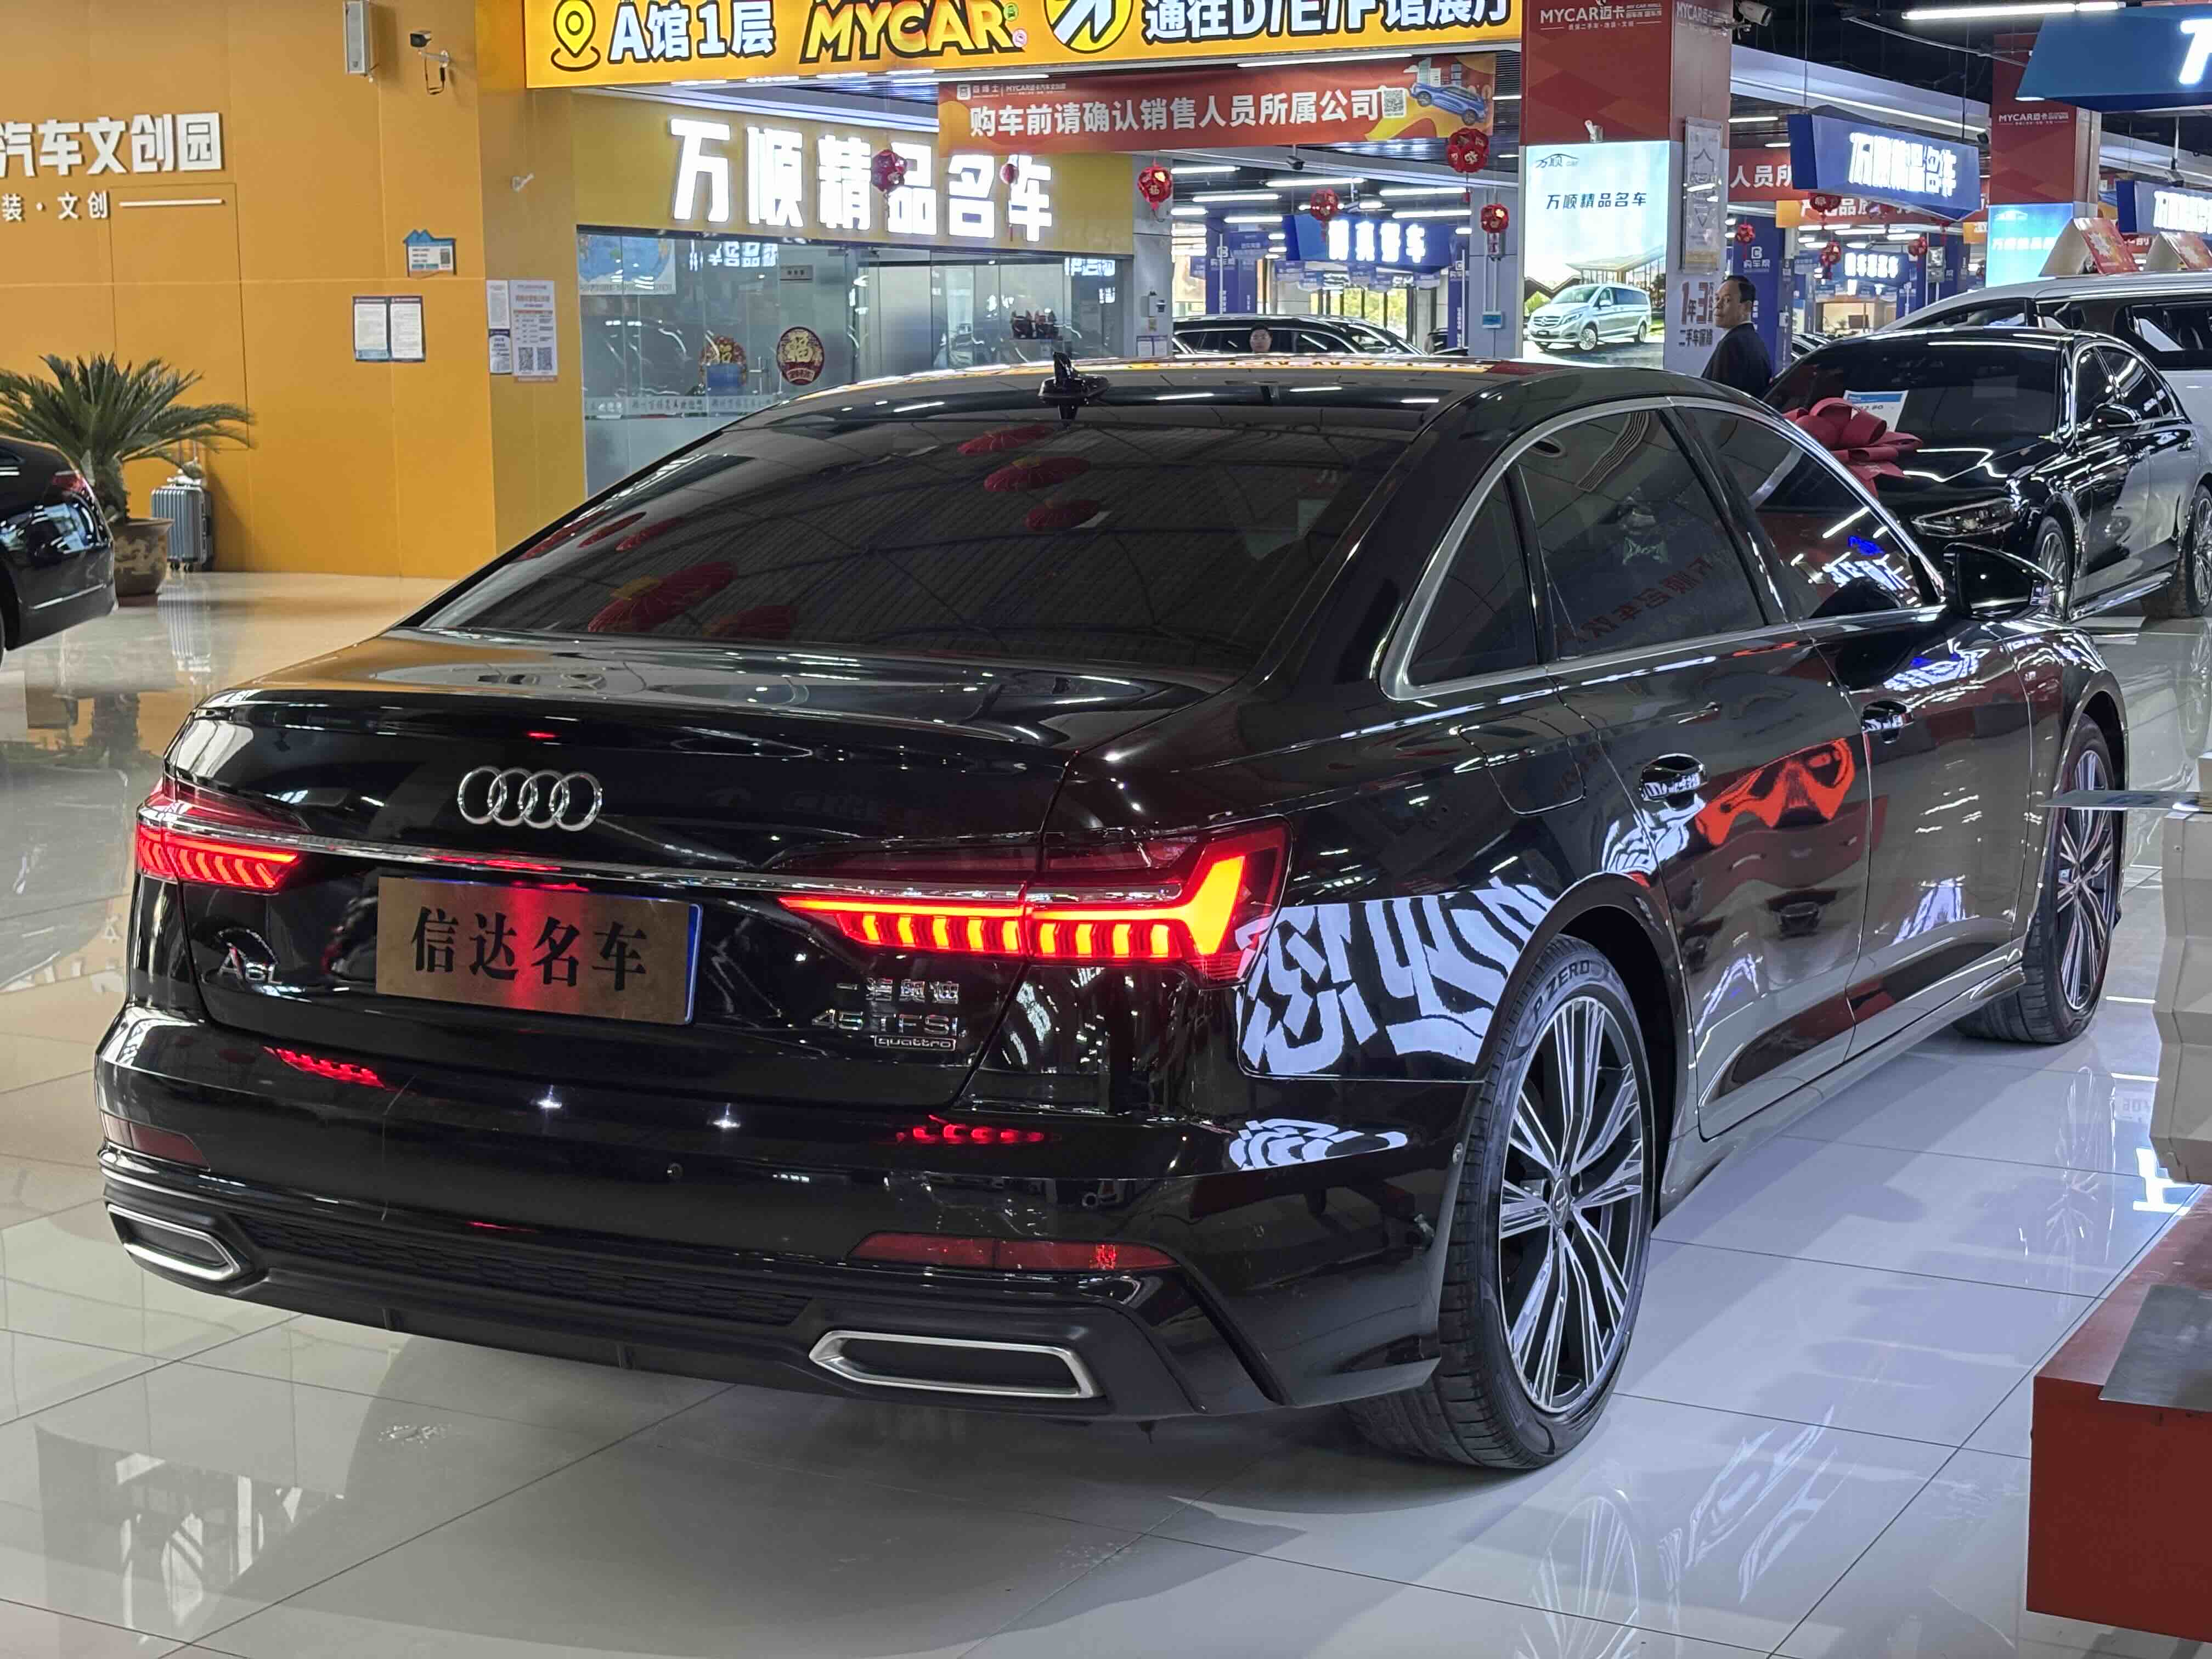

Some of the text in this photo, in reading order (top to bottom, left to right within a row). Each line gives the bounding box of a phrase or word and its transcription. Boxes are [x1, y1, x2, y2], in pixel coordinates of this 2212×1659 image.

[608, 1, 775, 62] A馆1层
[803, 0, 1018, 62] MYCAR
[970, 88, 1378, 137] 购车前请确认销售人员所属公司
[0, 112, 222, 178] 汽车文创园
[670, 119, 1053, 241] 万顺精品名车
[1546, 192, 1647, 210] 万顺精品名车
[217, 946, 283, 985] A6L
[410, 906, 647, 991] 信达名车
[1545, 960, 1590, 1001] ZERO
[812, 1008, 959, 1036] 45 TFSI
[877, 1037, 952, 1049] quattro
